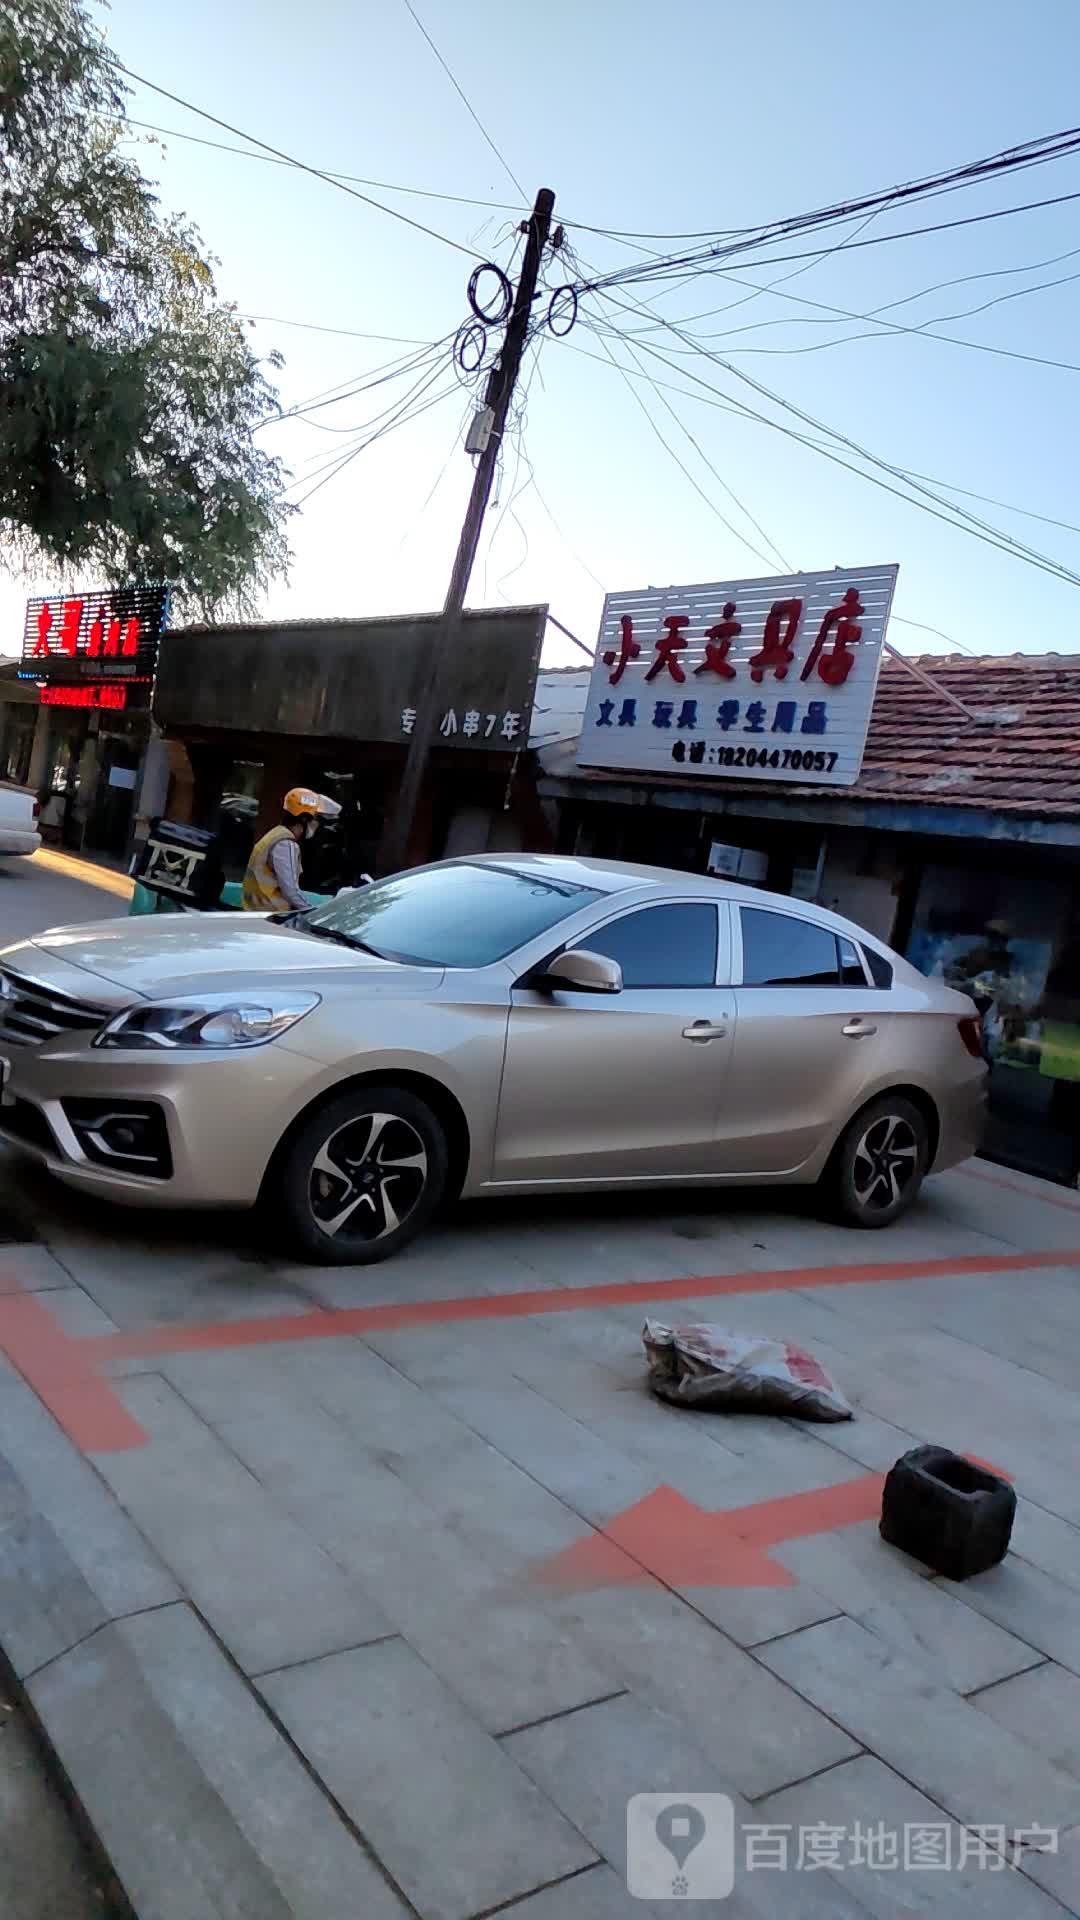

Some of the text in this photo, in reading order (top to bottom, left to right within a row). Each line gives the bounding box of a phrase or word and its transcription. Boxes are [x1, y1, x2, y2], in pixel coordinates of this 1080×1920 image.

[603, 587, 864, 686] 小天文具店
[401, 707, 521, 740] 专小串7年
[596, 699, 828, 734] 文具 玩具 学生用品
